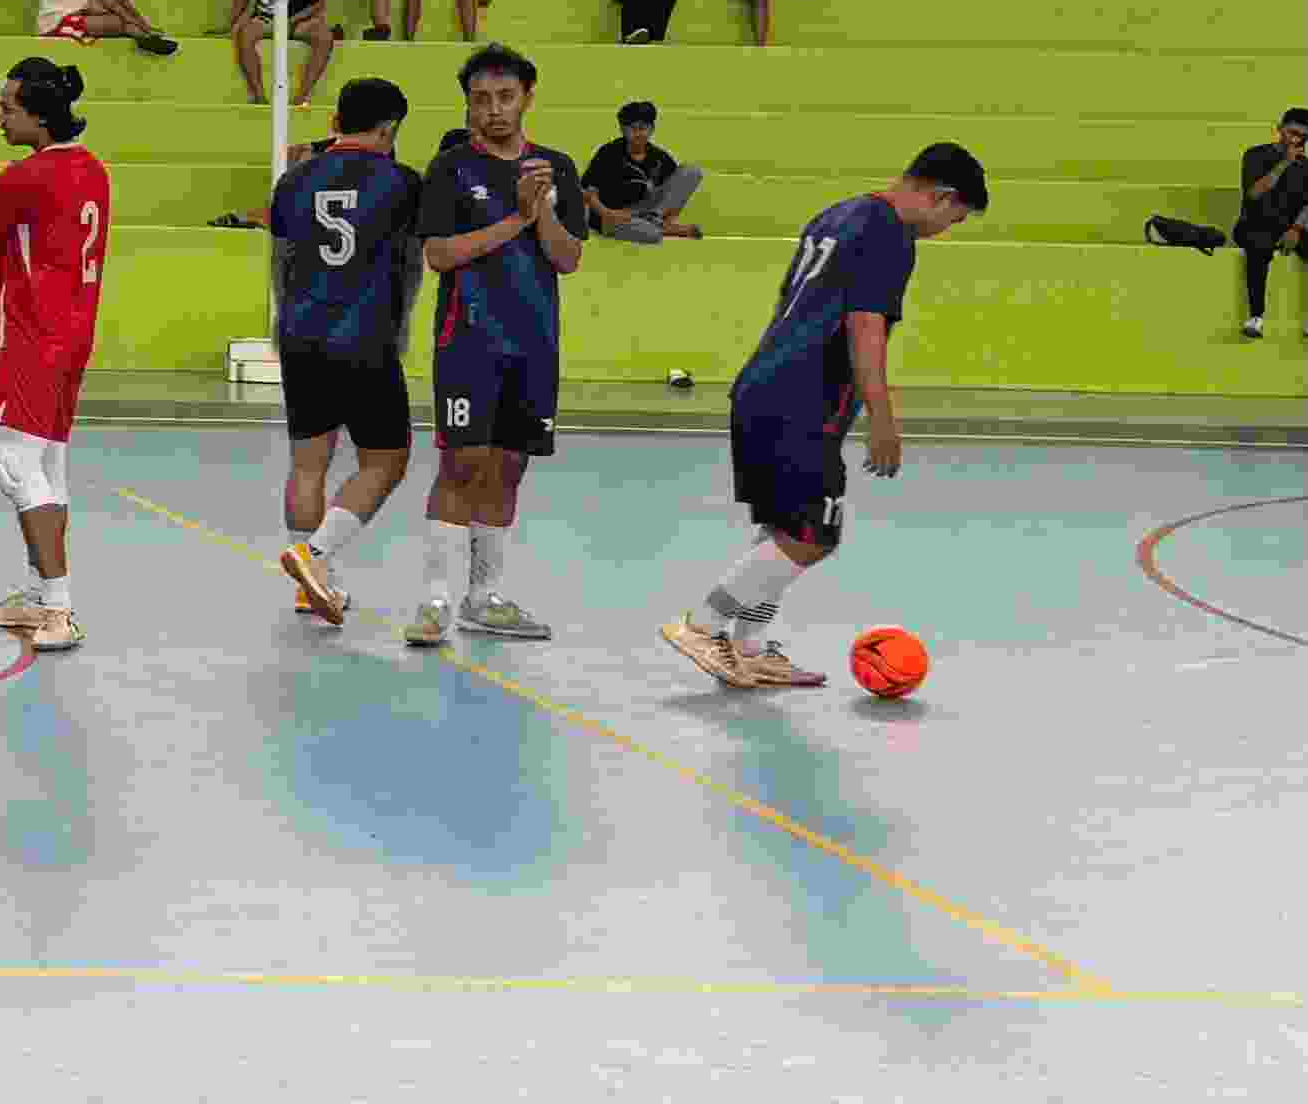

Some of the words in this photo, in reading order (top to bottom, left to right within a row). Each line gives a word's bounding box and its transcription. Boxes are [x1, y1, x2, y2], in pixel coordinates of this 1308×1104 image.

[80, 200, 101, 283] 2
[314, 190, 359, 266] 5
[446, 397, 471, 427] 18
